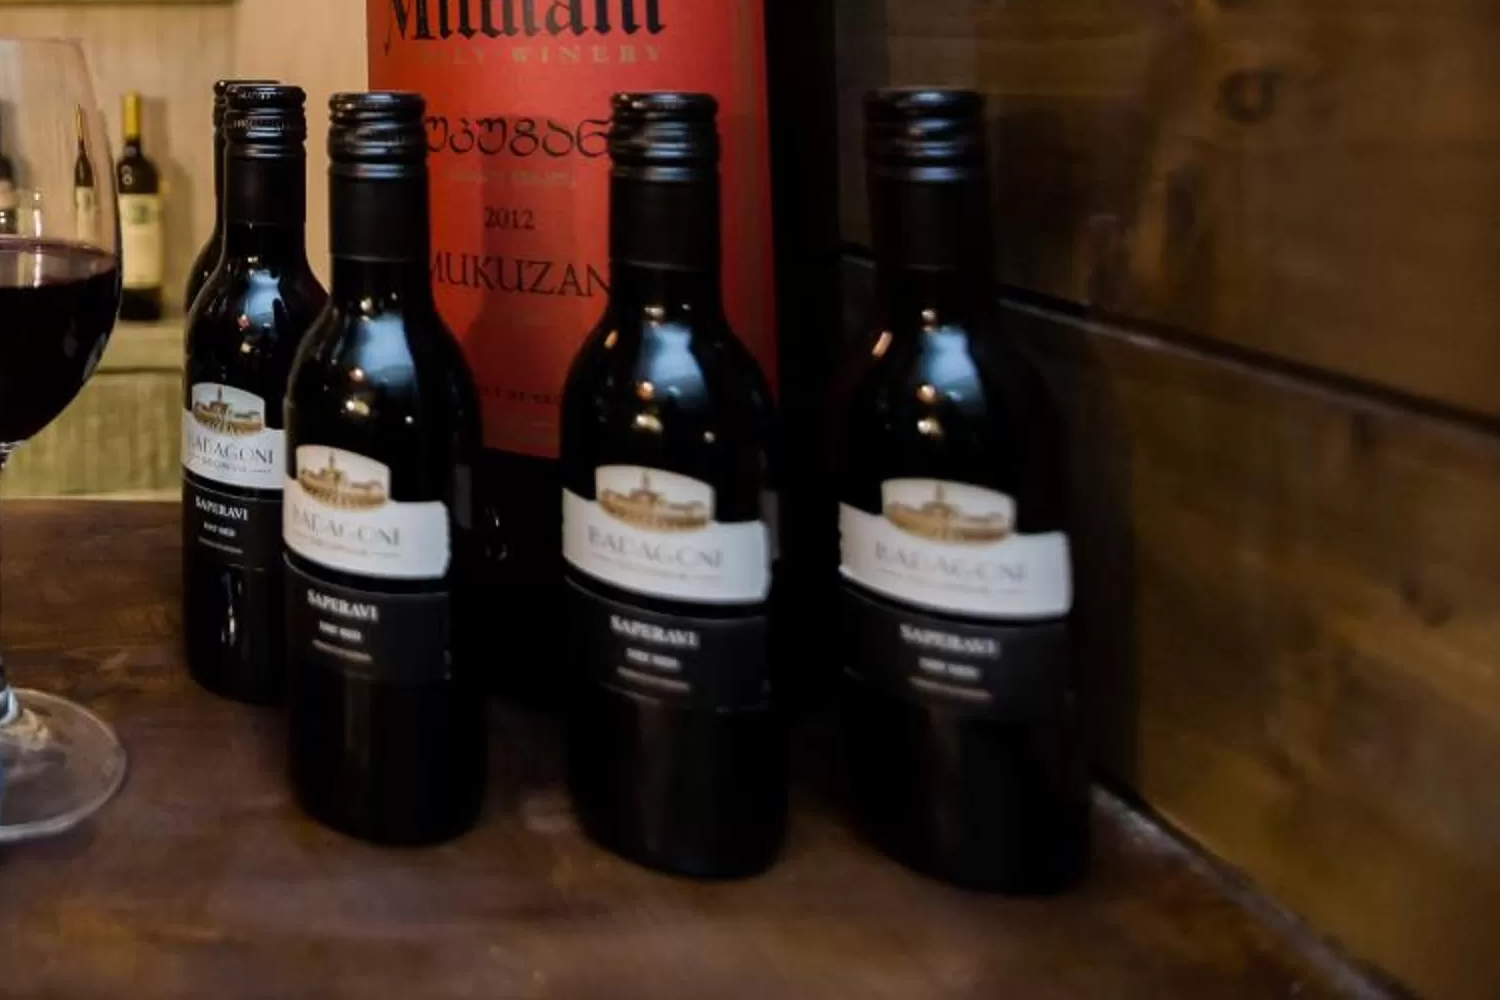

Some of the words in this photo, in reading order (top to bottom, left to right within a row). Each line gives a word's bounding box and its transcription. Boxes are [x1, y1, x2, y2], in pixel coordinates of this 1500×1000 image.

[510, 44, 663, 64] WINERY
[425, 115, 610, 158] უკუზან
[483, 206, 536, 231] 2012
[431, 250, 610, 298] MUKUZAN
[195, 494, 249, 522] SAPERAVI
[306, 587, 378, 622] SAPERAVI
